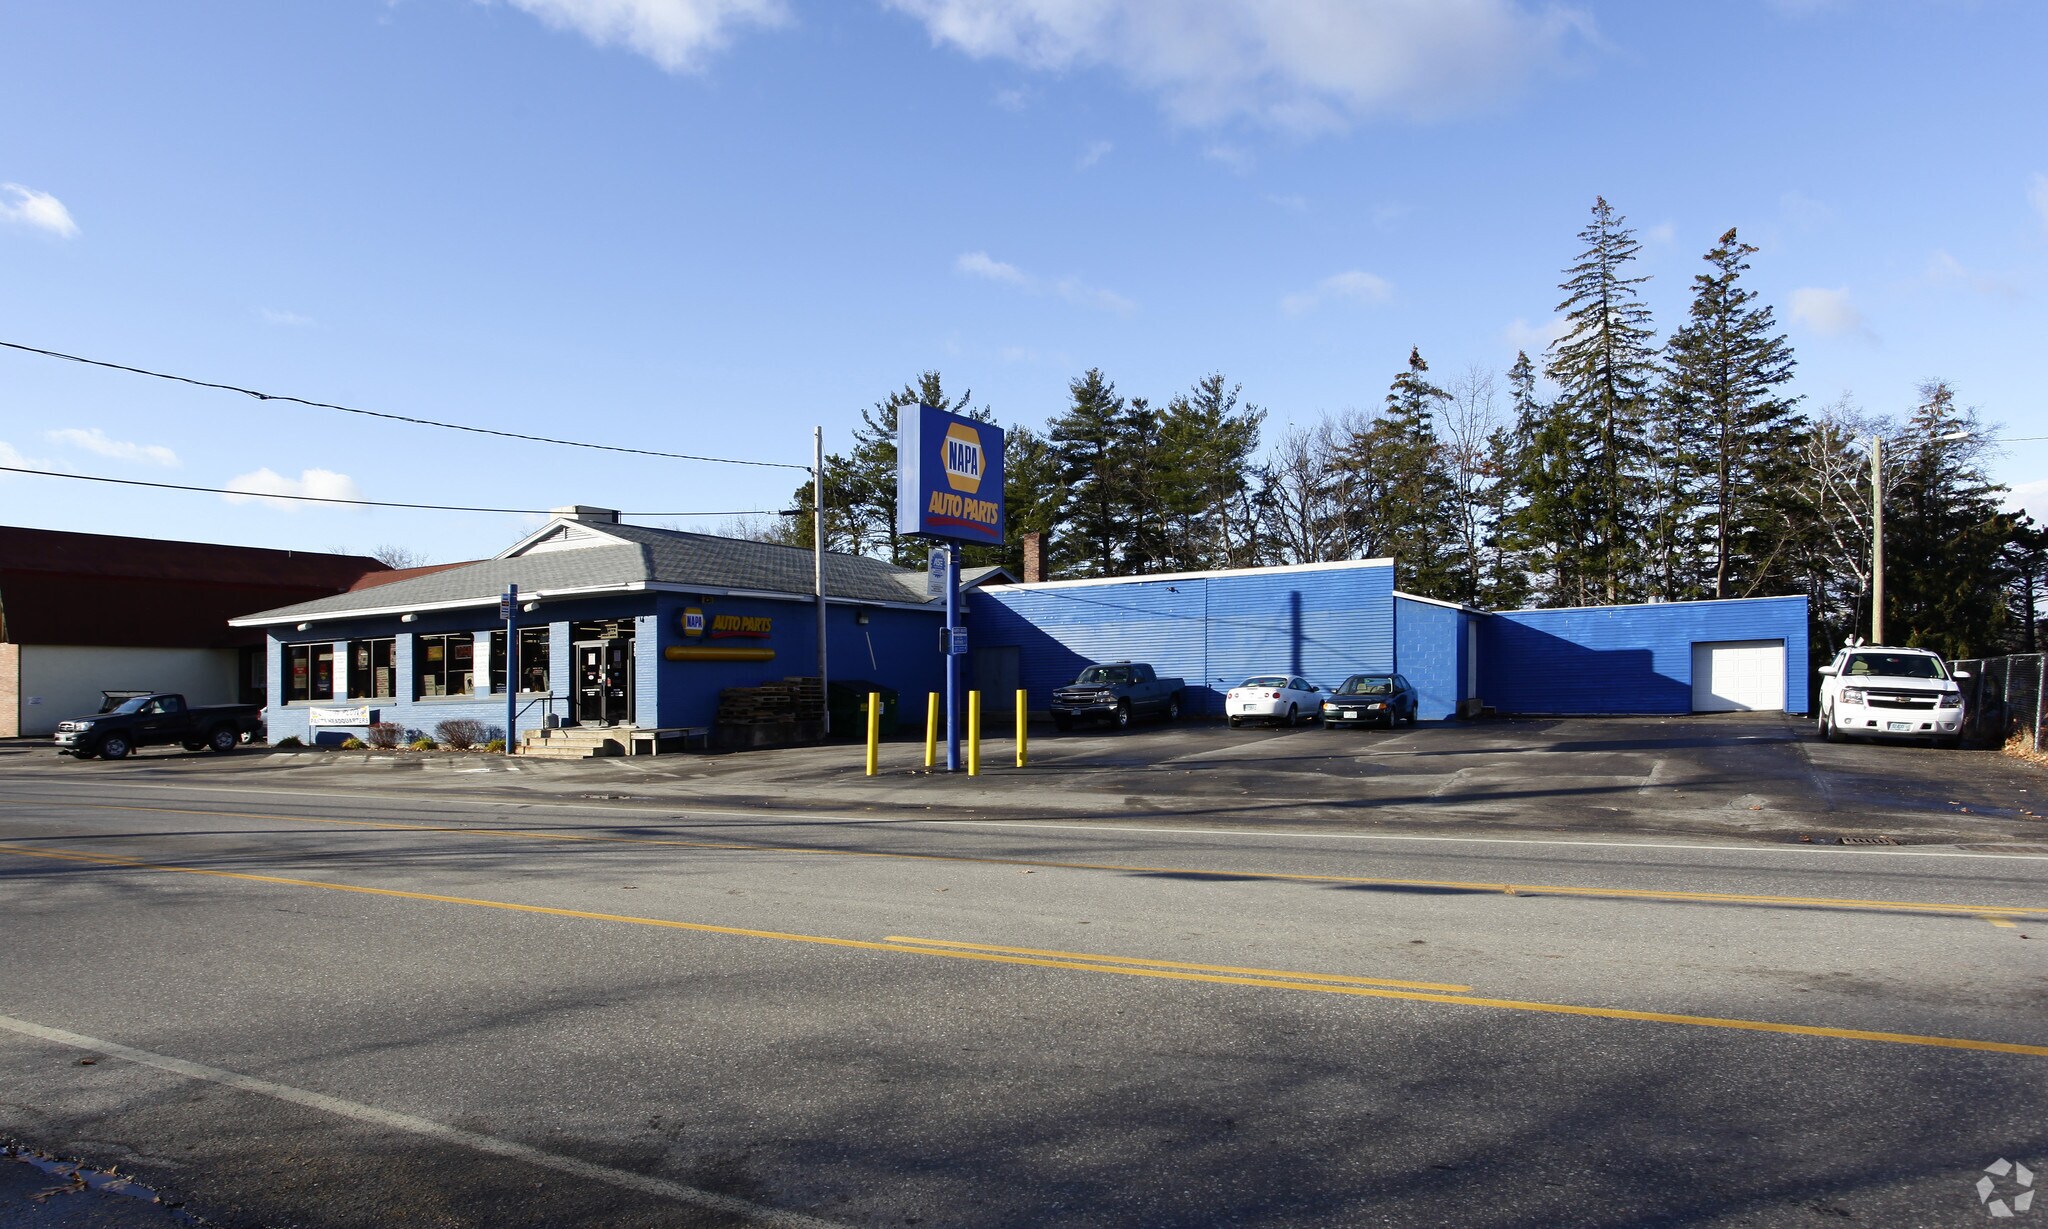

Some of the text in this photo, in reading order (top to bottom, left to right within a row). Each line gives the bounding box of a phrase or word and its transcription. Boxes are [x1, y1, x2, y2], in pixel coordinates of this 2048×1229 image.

[949, 441, 978, 476] NAPA
[928, 490, 998, 525] AUTO PARTS
[686, 615, 702, 629] NAPA
[712, 615, 772, 632] AUTO PARTS
